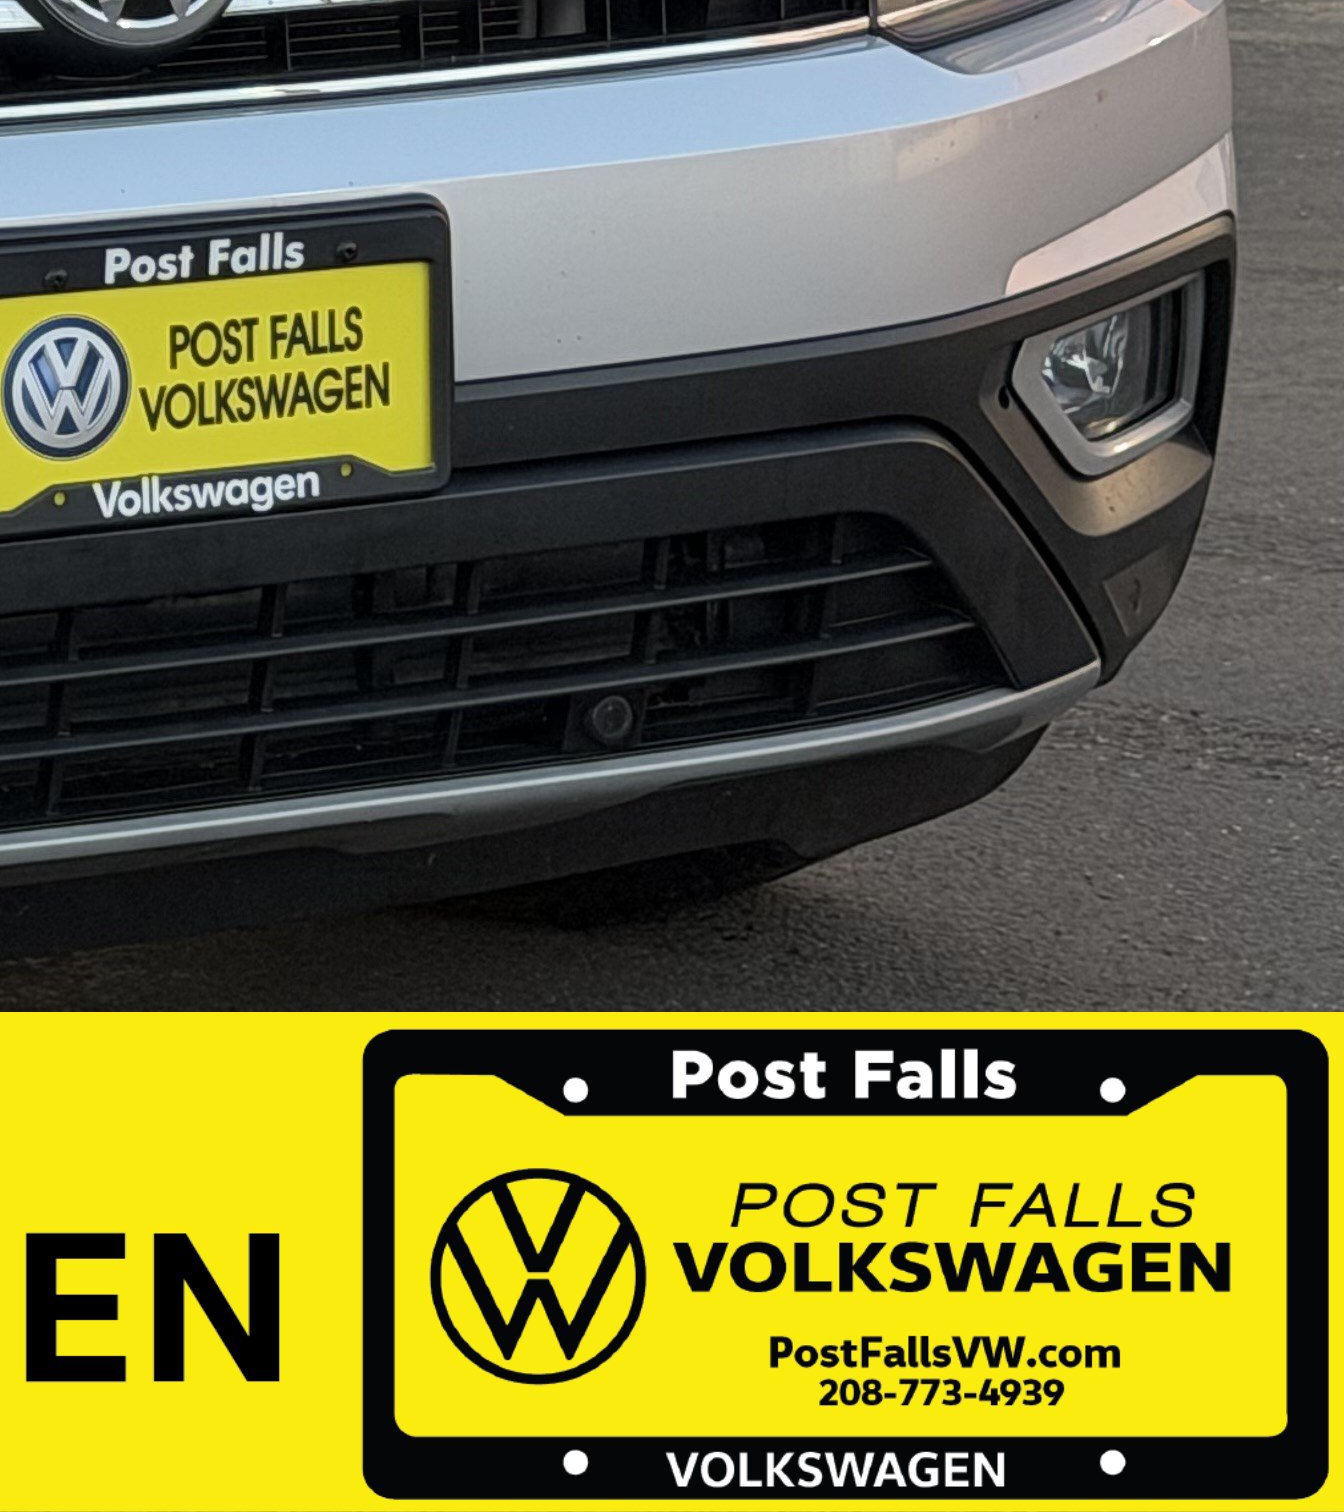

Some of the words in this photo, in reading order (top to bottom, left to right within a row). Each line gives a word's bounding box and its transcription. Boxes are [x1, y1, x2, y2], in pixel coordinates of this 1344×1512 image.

[104, 245, 195, 285] Post
[208, 231, 305, 276] Falls
[169, 317, 259, 370] POST
[269, 306, 363, 359] FALLS
[138, 361, 390, 432] VOLKSWAGEN
[92, 470, 320, 519] Volkswagen
